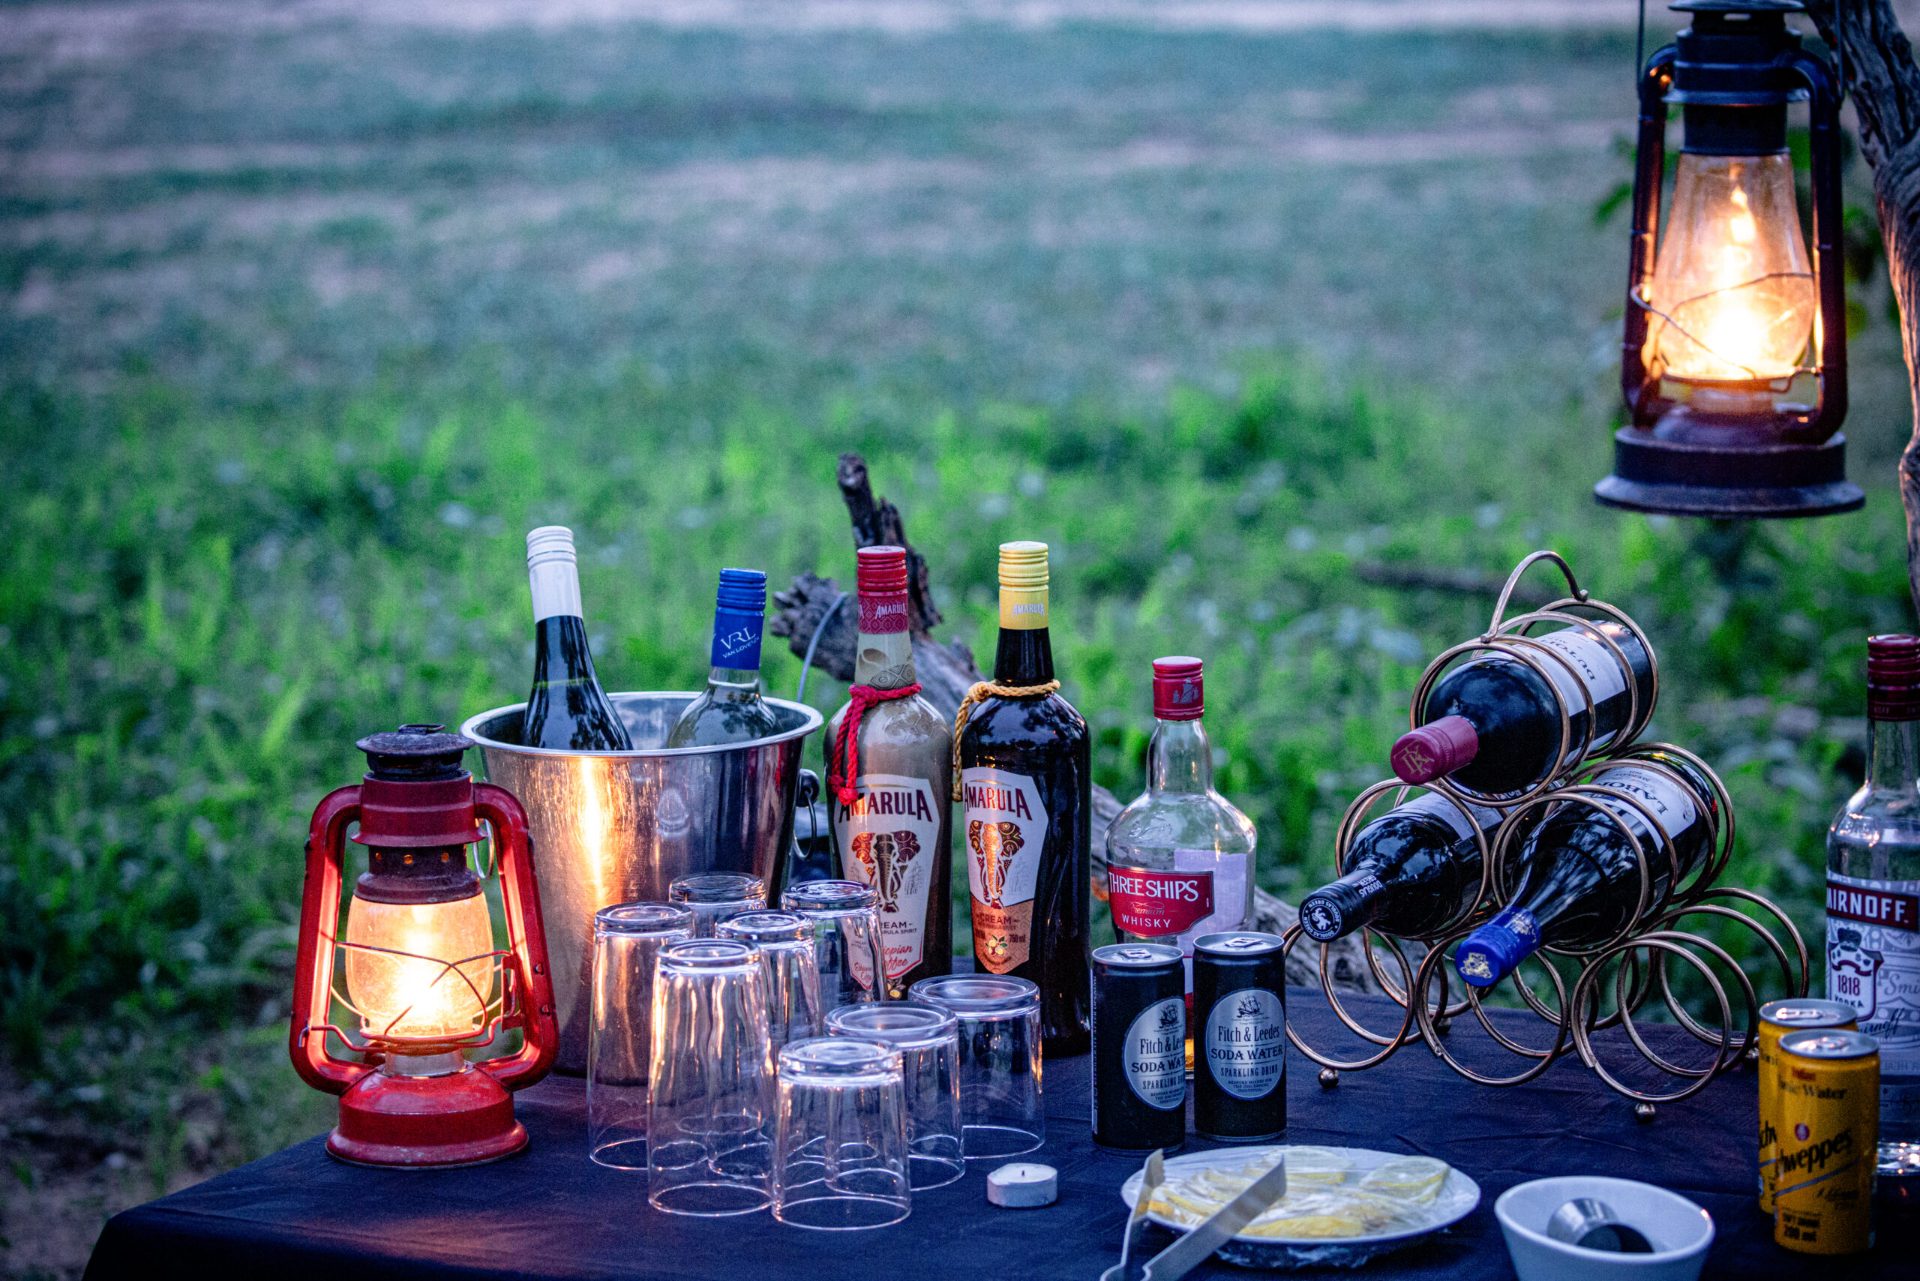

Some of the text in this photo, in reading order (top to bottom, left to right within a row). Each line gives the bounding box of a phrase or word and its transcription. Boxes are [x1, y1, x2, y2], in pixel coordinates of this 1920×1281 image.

[875, 602, 908, 619] AMARULA
[1012, 603, 1045, 617] AMARULA
[720, 627, 756, 649] VRL
[839, 789, 933, 823] AMARULA
[963, 783, 1033, 821] AMARULA
[1108, 872, 1199, 902] THREE SHIPS
[880, 921, 907, 930] EAM
[979, 913, 1013, 925] CREAM
[1121, 913, 1171, 928] WHISKY
[1837, 975, 1861, 996] 1818
[1218, 1024, 1280, 1042] Fitch & Leedes
[1140, 1037, 1163, 1054] Fitch
[1165, 1036, 1172, 1052] &
[1210, 1044, 1283, 1060] SODA WATER
[1131, 1060, 1165, 1073] SODA
[1220, 1066, 1259, 1078] SPARKLING
[1142, 1076, 1177, 1090] SPARKLING
[1803, 1083, 1848, 1100] Water
